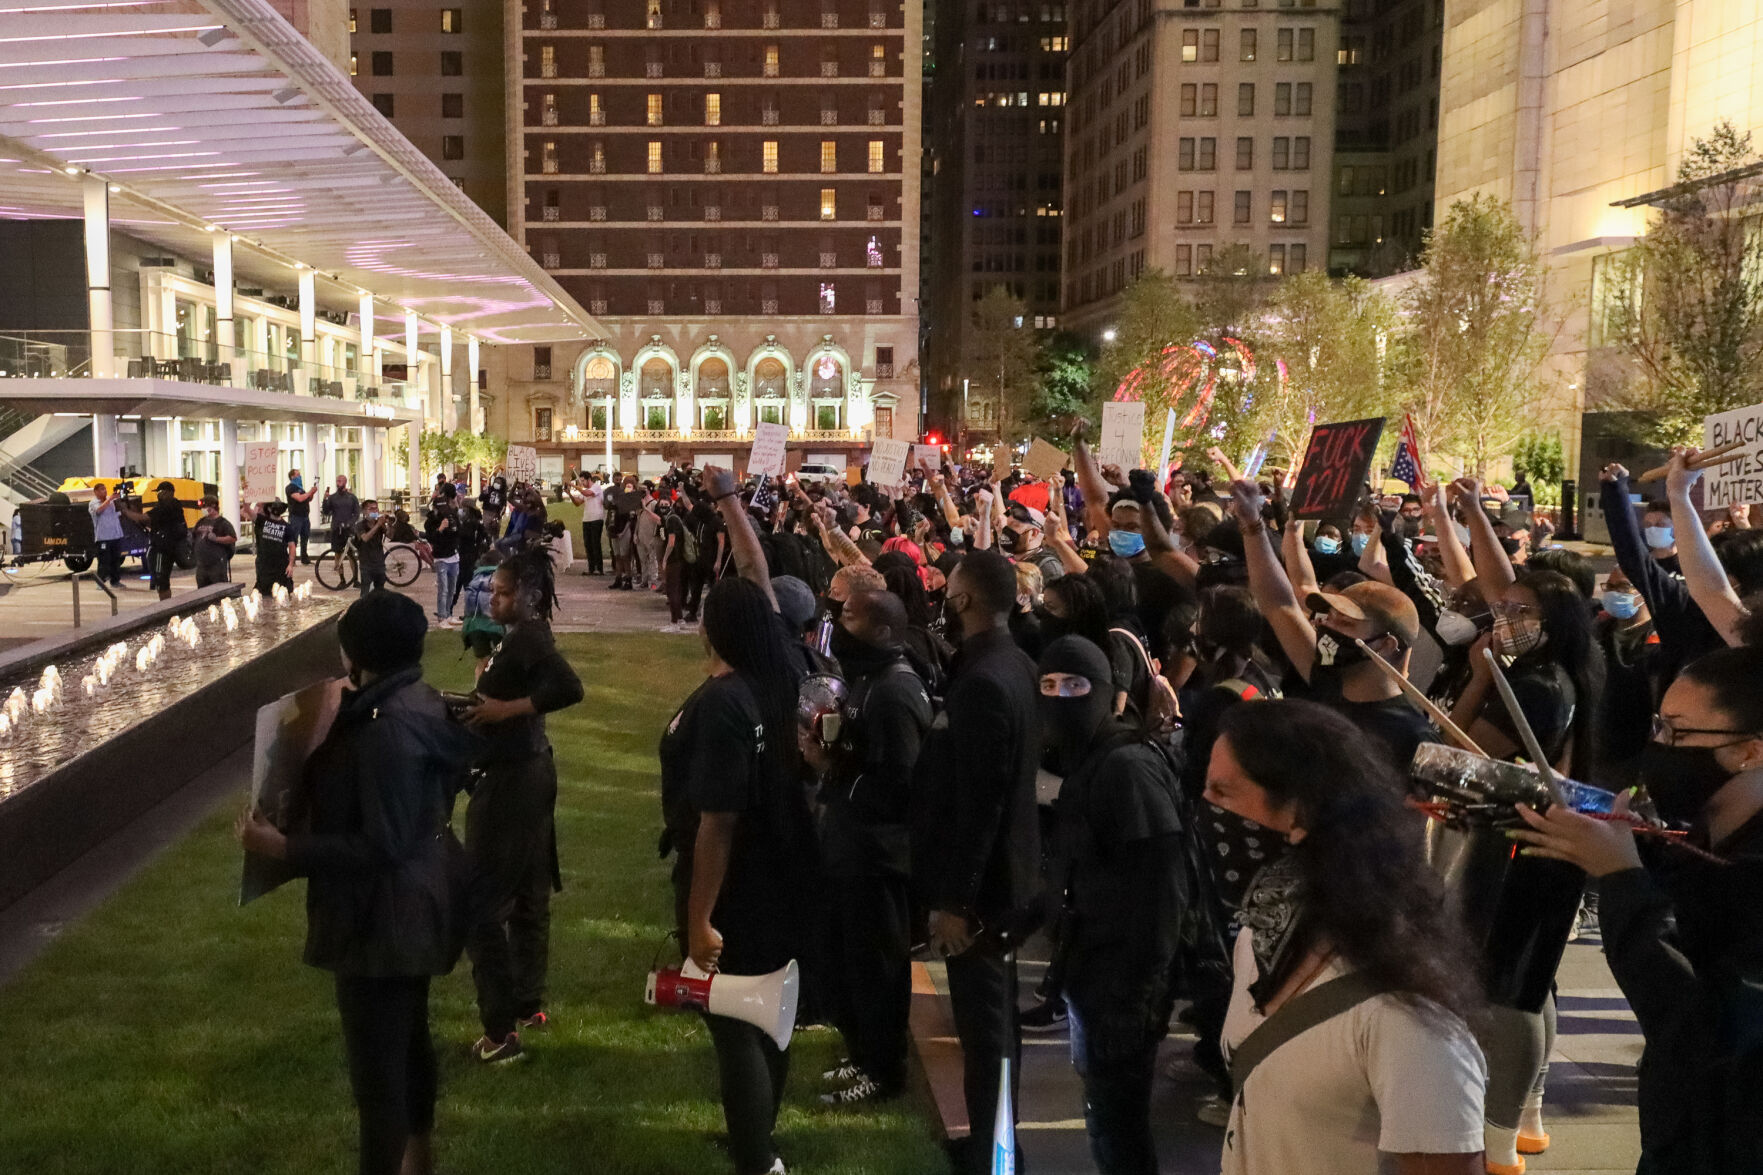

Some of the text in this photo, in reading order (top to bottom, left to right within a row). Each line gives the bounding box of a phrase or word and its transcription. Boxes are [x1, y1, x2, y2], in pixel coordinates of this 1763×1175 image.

[1114, 429, 1124, 449] 4
[1713, 416, 1763, 448] BLACK
[508, 446, 536, 458] BLACK
[1305, 424, 1371, 468] FUCK
[250, 447, 276, 460] STOP
[247, 463, 277, 477] POLICE
[508, 457, 536, 471] LIVES
[1719, 450, 1763, 478] LIVES
[507, 470, 536, 482] MATTER
[243, 486, 276, 498] BRUTALITY
[1710, 478, 1763, 506] MATTER
